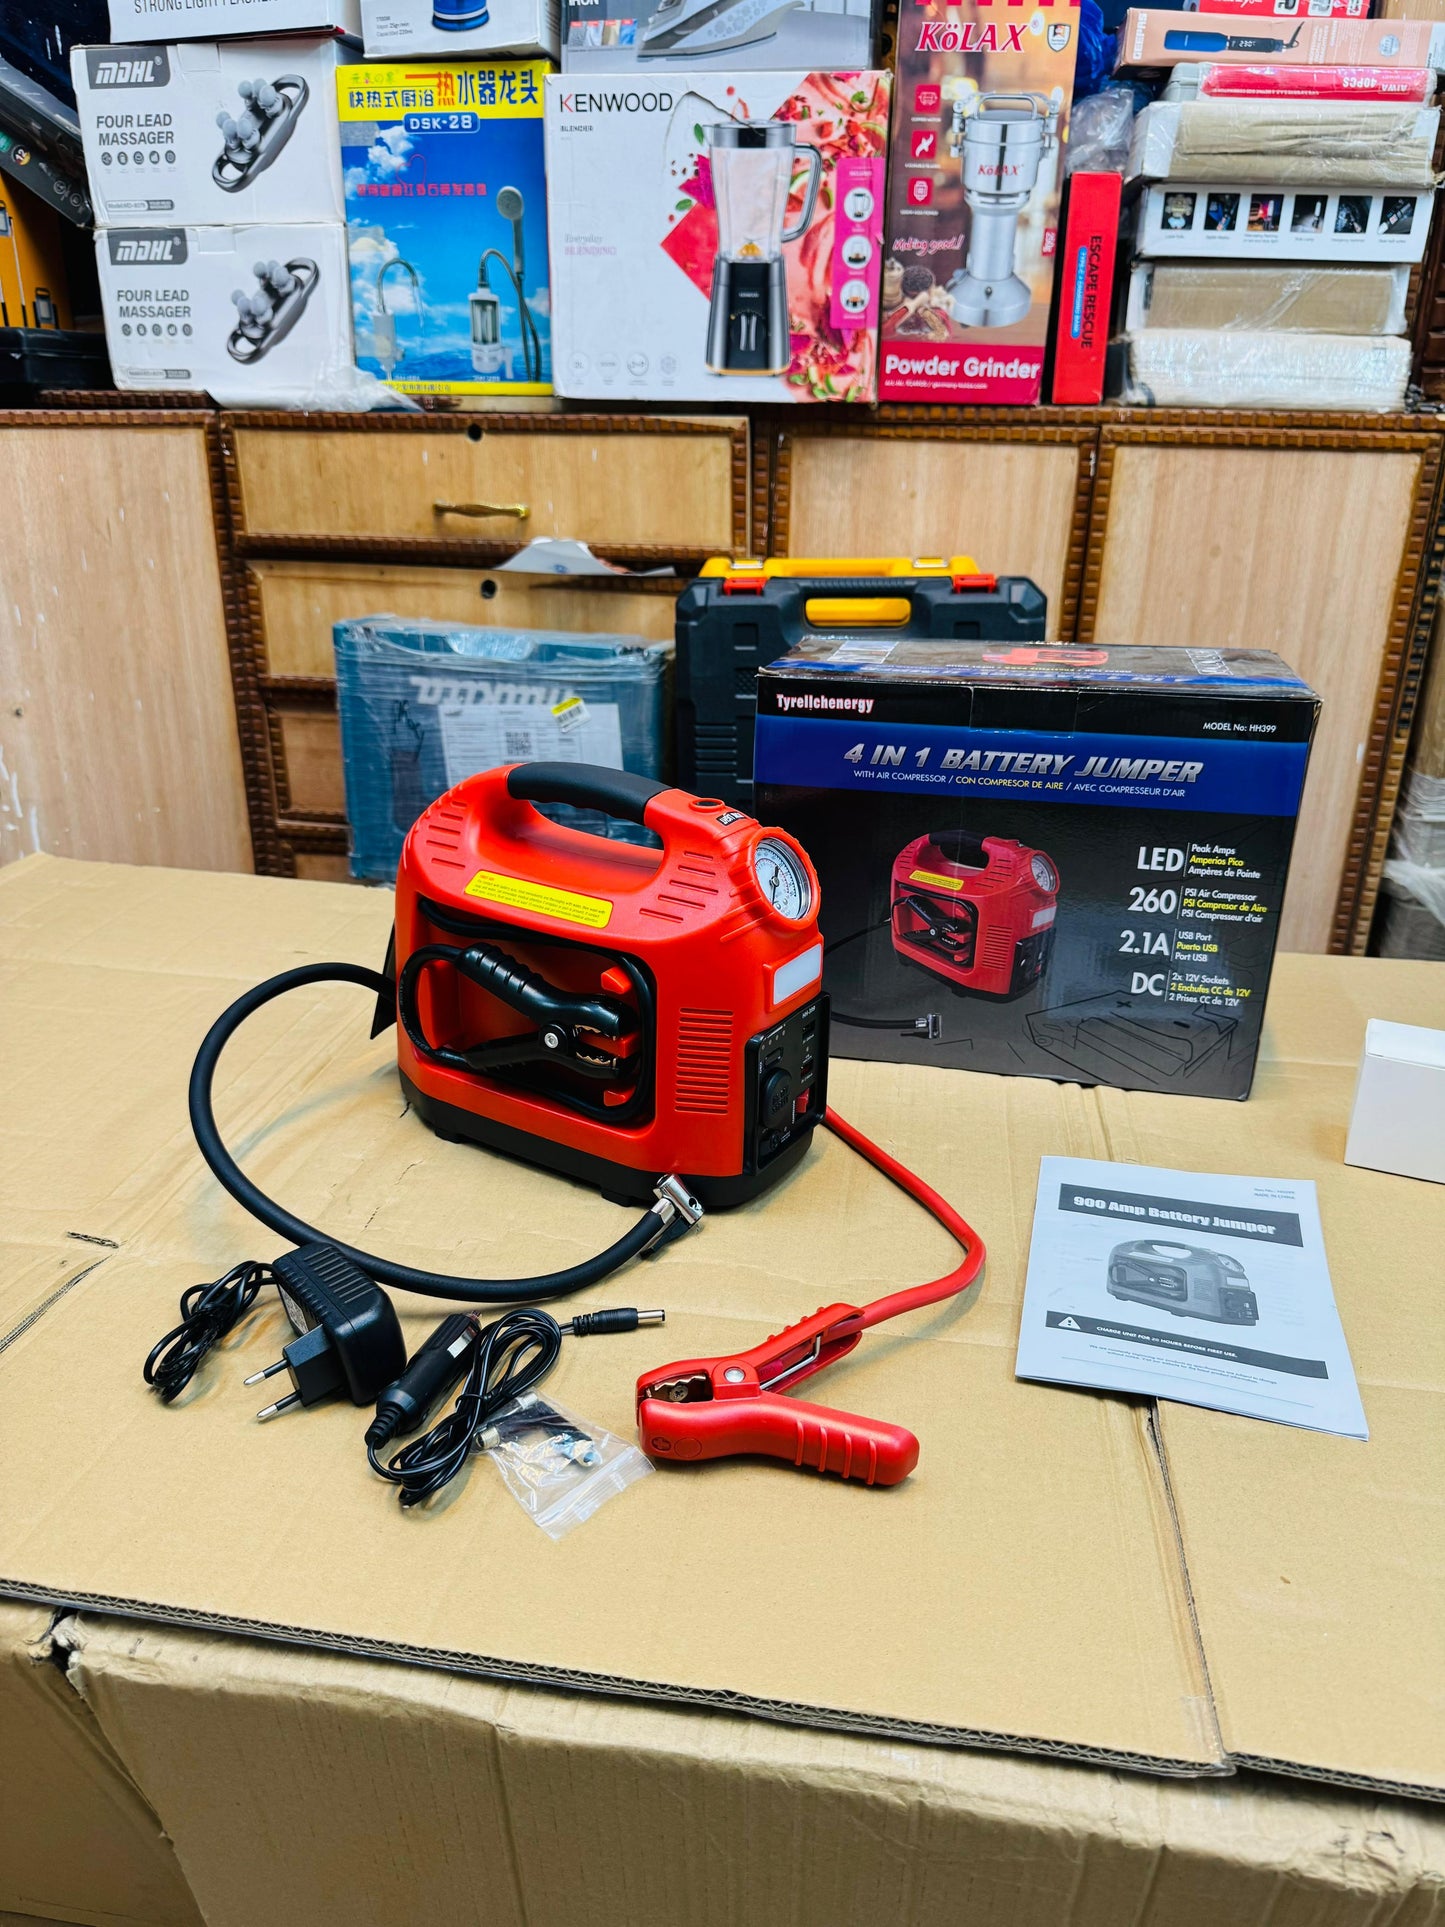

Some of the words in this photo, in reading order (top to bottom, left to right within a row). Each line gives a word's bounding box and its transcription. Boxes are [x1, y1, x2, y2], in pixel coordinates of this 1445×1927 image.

[134, 0, 182, 14] STRONG
[95, 60, 155, 84] MDHL
[1342, 76, 1378, 88] 40PCS
[559, 92, 673, 113] KENWOOD
[96, 115, 135, 129] FOUR
[136, 113, 173, 127] LEAD
[409, 114, 473, 130] DSK-28
[98, 130, 175, 146] MASSAGER
[115, 239, 174, 261] MDHL
[1085, 235, 1102, 291] ESCAPE
[117, 290, 153, 303] FOUR
[155, 289, 190, 302] LEAD
[119, 305, 192, 318] MASSAGER
[1081, 294, 1097, 349] RESCUE
[885, 354, 960, 377] Powder
[963, 356, 1041, 379] Grinder
[1202, 721, 1232, 732] MODEL
[1233, 723, 1248, 732] No:
[1248, 724, 1277, 733] HH399
[843, 743, 865, 764] 4
[870, 744, 907, 766] IN
[914, 747, 931, 768] 1
[940, 748, 1076, 775] BATTERY
[1073, 756, 1205, 783] JUMPER
[853, 769, 875, 779] WITH
[876, 771, 890, 780] AIR
[891, 772, 947, 783] COMPRESSOR
[955, 776, 977, 785] CON
[977, 776, 1030, 788] COMPRESOR
[1031, 781, 1043, 789] DE
[1044, 781, 1064, 790] AIRE
[1073, 783, 1097, 792] AVEC
[1098, 784, 1161, 796] COMPRESSEUR
[1191, 843, 1211, 854] Peak
[1211, 844, 1236, 856] Amps
[1136, 846, 1185, 872] LED
[1189, 854, 1226, 866] Amperios
[1227, 856, 1244, 866] Pico
[1187, 865, 1222, 877] Ampères
[1223, 867, 1234, 877] de
[1235, 868, 1261, 879] Pointe
[1127, 886, 1178, 914] 260
[1184, 887, 1197, 897] PSI
[1197, 888, 1211, 898] Air
[1211, 889, 1257, 902] Compressor
[1183, 899, 1195, 908] PSI
[1196, 900, 1238, 913] Compresor
[1238, 901, 1250, 911] de
[1250, 902, 1268, 913] Aire
[1181, 909, 1194, 918] PSI
[1194, 910, 1244, 923] Compresseur
[1118, 929, 1170, 956] 2.1A
[1178, 931, 1194, 940] USB
[1195, 931, 1213, 942] Port
[1176, 941, 1201, 951] Puerto
[1202, 943, 1218, 953] USB
[1174, 952, 1193, 962] Port
[1193, 953, 1208, 963] USB
[1130, 971, 1166, 997] DC
[1171, 972, 1182, 981] 2x
[1184, 973, 1200, 983] 12V
[1200, 973, 1230, 985] Sockets
[1170, 982, 1176, 991] 2
[1177, 983, 1210, 994] Enchufes
[1211, 985, 1222, 995] CC
[1223, 986, 1234, 996] de
[1236, 988, 1252, 998] 12V
[1169, 993, 1176, 1001] 2
[1176, 993, 1197, 1004] Prises
[1199, 995, 1211, 1004] CC
[1211, 996, 1222, 1006] de
[1224, 997, 1240, 1007] 12V
[1073, 1196, 1106, 1210] 900
[1108, 1202, 1146, 1217] Amp
[1148, 1207, 1211, 1227] Battery
[1212, 1215, 1277, 1236] Jumper
[1096, 1326, 1121, 1335] CHARGE
[1160, 1338, 1183, 1347] HOURS
[1183, 1342, 1206, 1352] BEFORE
[1207, 1347, 1223, 1355] FIRST
